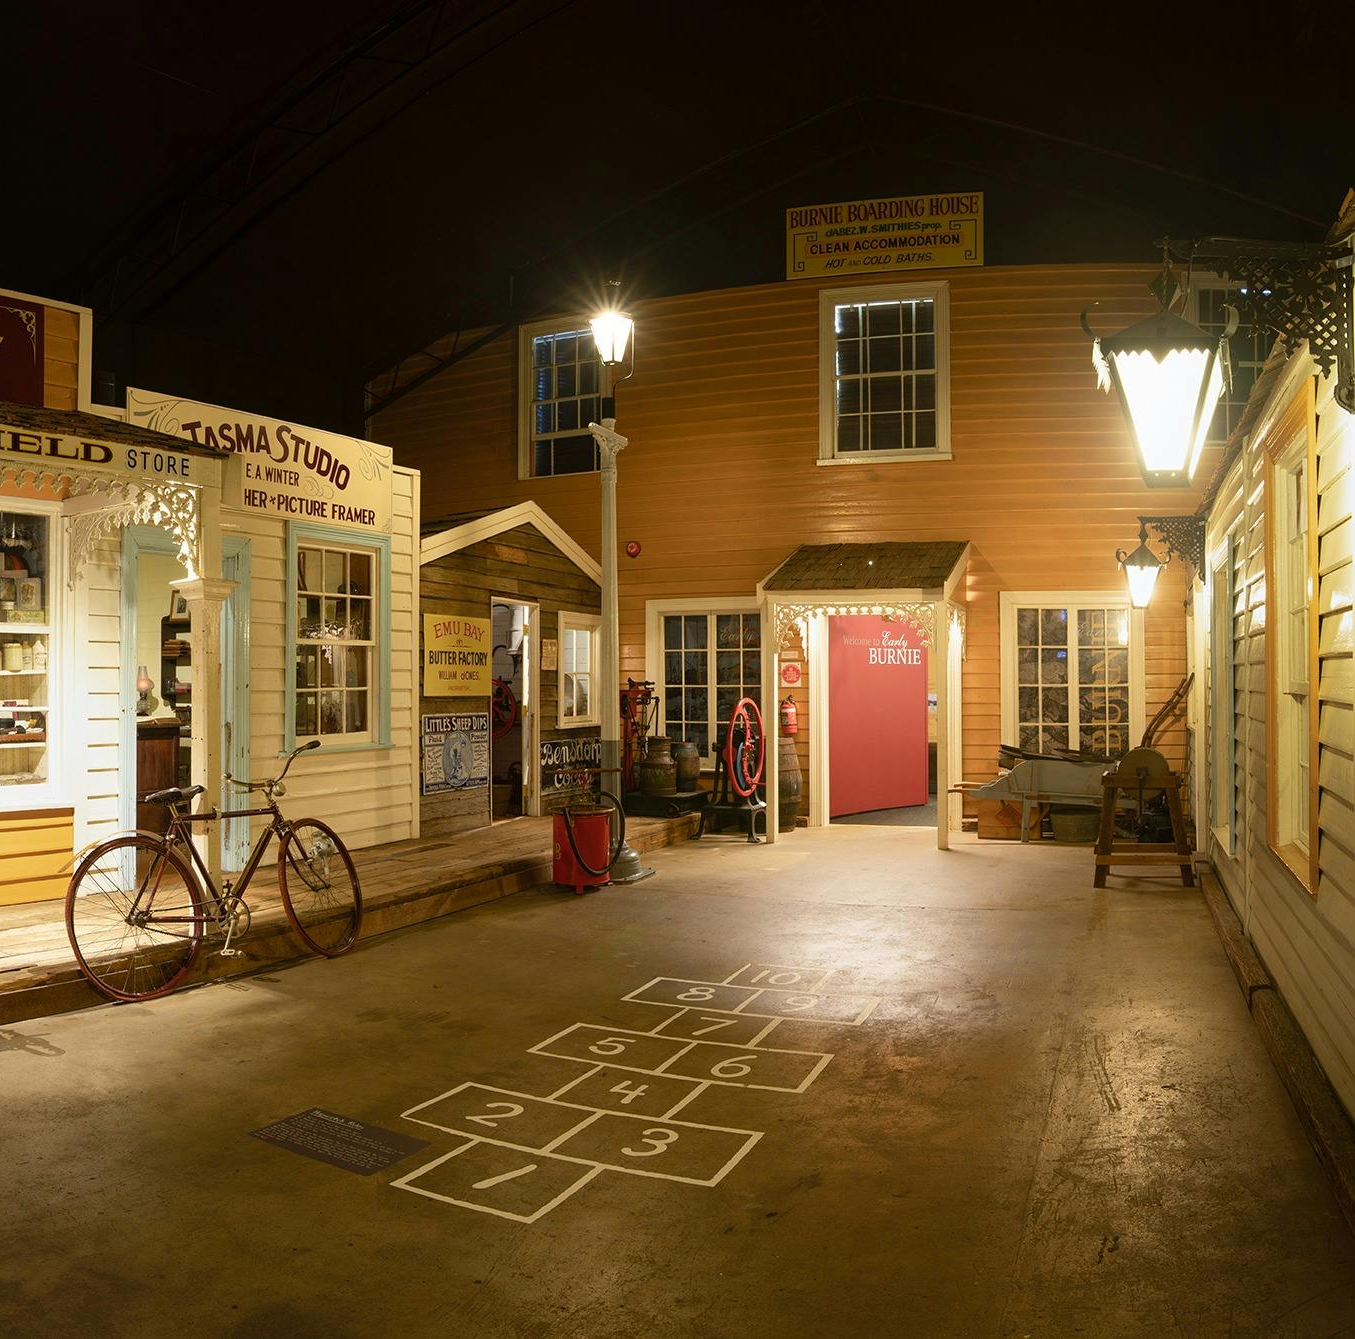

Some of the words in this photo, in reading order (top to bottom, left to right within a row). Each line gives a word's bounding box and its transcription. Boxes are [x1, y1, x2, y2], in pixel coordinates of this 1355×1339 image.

[790, 207, 843, 229] BURNIE
[847, 199, 925, 224] BOARDING
[929, 195, 979, 216] HOUSE
[810, 241, 850, 255] CLEAN
[853, 234, 960, 252] ACCOMMODATION
[826, 258, 846, 269] HOT
[863, 254, 891, 266] COLD
[126, 448, 190, 477] STORE
[181, 421, 272, 456] TASMA
[269, 424, 351, 491] STUDIO
[276, 493, 328, 519] PICTURE
[331, 503, 376, 526] FRAMER
[433, 621, 461, 640] EMU
[463, 622, 485, 642] BAY
[843, 635, 872, 646] Welcome
[873, 637, 880, 646] to
[881, 630, 909, 650] Early
[429, 650, 458, 665] BUTTER
[458, 651, 488, 666] FACTORY
[869, 648, 922, 665] BURNIE
[438, 671, 458, 680] WILLIAM
[452, 717, 472, 731] SHEEP
[472, 716, 488, 730] DIPS
[743, 967, 803, 985] 10
[676, 986, 718, 1001] 8
[786, 995, 818, 1013] 9
[692, 1018, 738, 1036] 7
[588, 1037, 637, 1055] 5
[709, 1055, 758, 1078] 6
[609, 1080, 649, 1104] 4
[465, 1102, 525, 1128] 2
[621, 1128, 680, 1157] 3
[471, 1164, 538, 1190] 1
